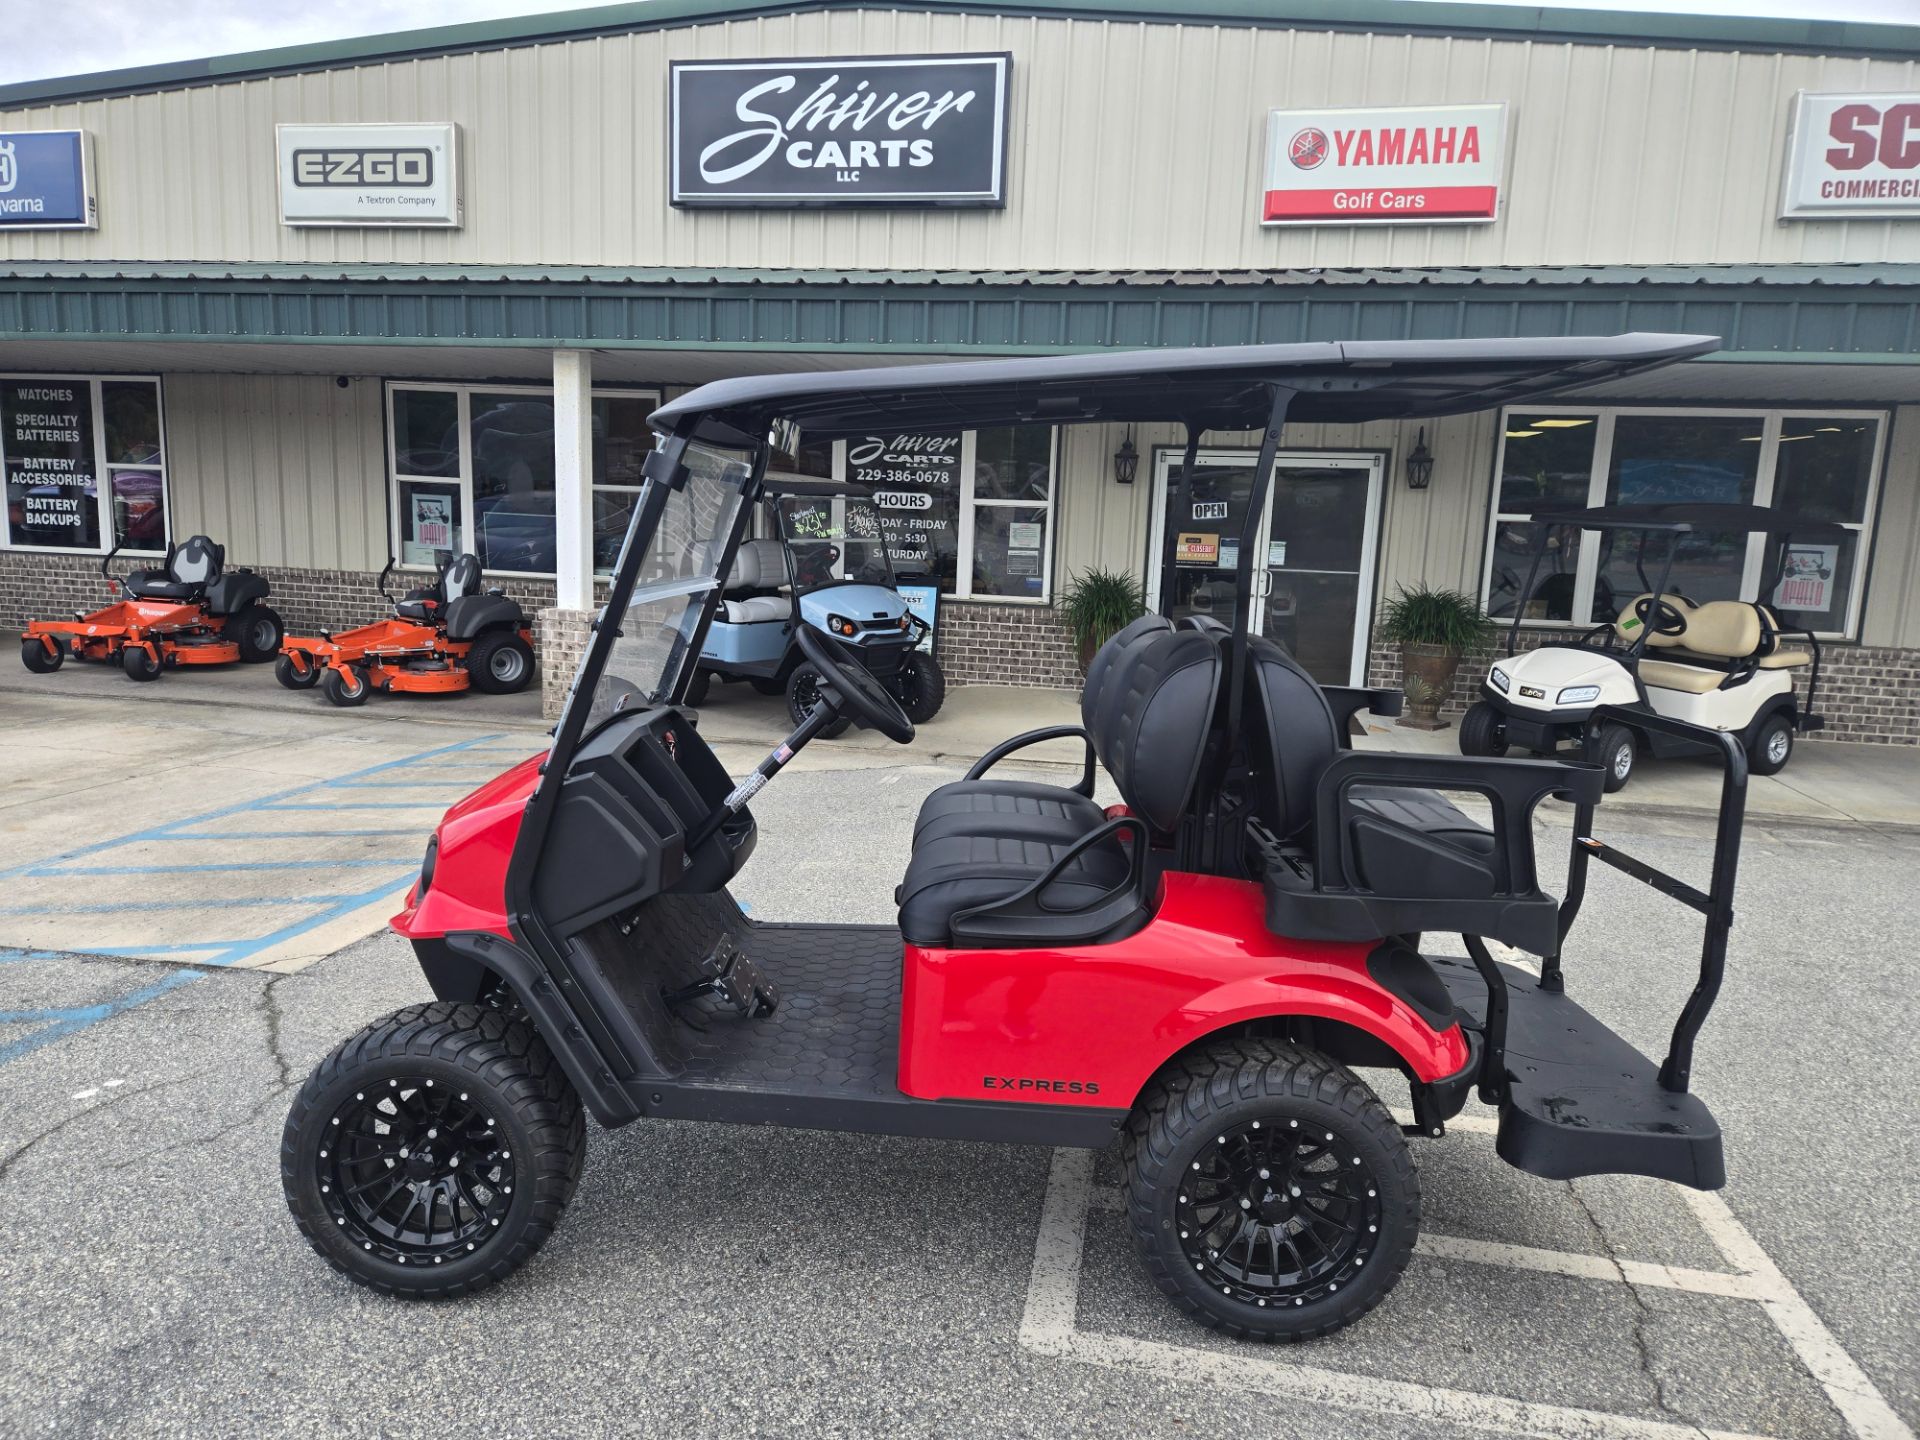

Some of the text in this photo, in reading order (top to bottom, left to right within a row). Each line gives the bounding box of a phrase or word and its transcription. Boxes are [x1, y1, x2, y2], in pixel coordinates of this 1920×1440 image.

[700, 74, 976, 184] Shiver
[1333, 126, 1480, 167] YAMAHA
[786, 140, 934, 167] CARTS
[297, 153, 428, 183] EZGO
[836, 171, 860, 182] LLC
[1821, 180, 1920, 199] COMMERCI
[0, 198, 44, 214] varna
[358, 196, 436, 207] A Textron Company
[1333, 191, 1425, 209] Golf Cars
[17, 388, 73, 401] WATCHES
[15, 414, 78, 427] SPECIALTY
[16, 429, 80, 443] BATTERIES
[23, 458, 76, 470] BATTERY
[883, 454, 955, 464] CARTS
[11, 473, 92, 486] ACCESSORIES
[856, 469, 950, 483] 229-386-0678
[26, 498, 78, 511] BATTERY
[879, 494, 926, 507] HOURS
[1194, 503, 1225, 518] OPEN
[26, 513, 81, 526] BACKUPS
[909, 519, 948, 530] FRIDAY
[904, 533, 927, 543] 5:30
[983, 1076, 1100, 1094] EXPRESS
